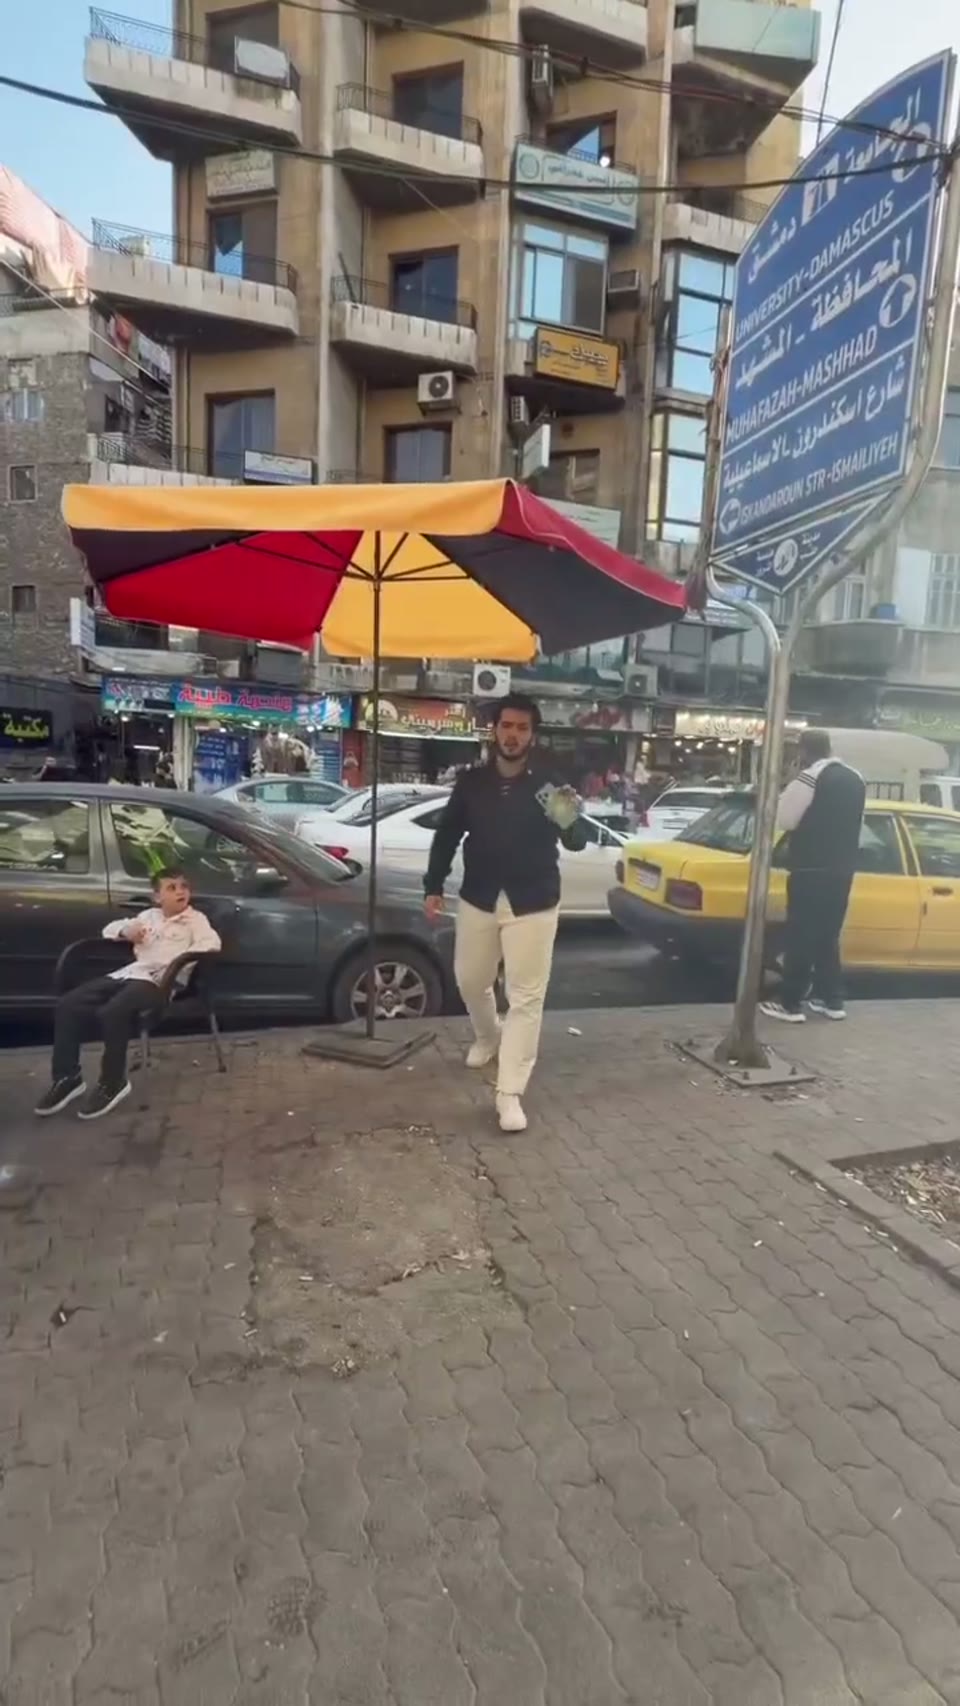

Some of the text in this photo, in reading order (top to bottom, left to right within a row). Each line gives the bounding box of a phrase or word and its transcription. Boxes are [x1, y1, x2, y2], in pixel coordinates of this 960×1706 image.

[735, 189, 895, 342] UNIVERSITY-DAMASCUS
[748, 216, 797, 285] دمشق
[810, 226, 913, 332] المحافظة
[726, 325, 878, 447] MUHAFAZAH-MASHHAD
[865, 354, 905, 421] شارع
[3, 712, 50, 743] مكتبة
